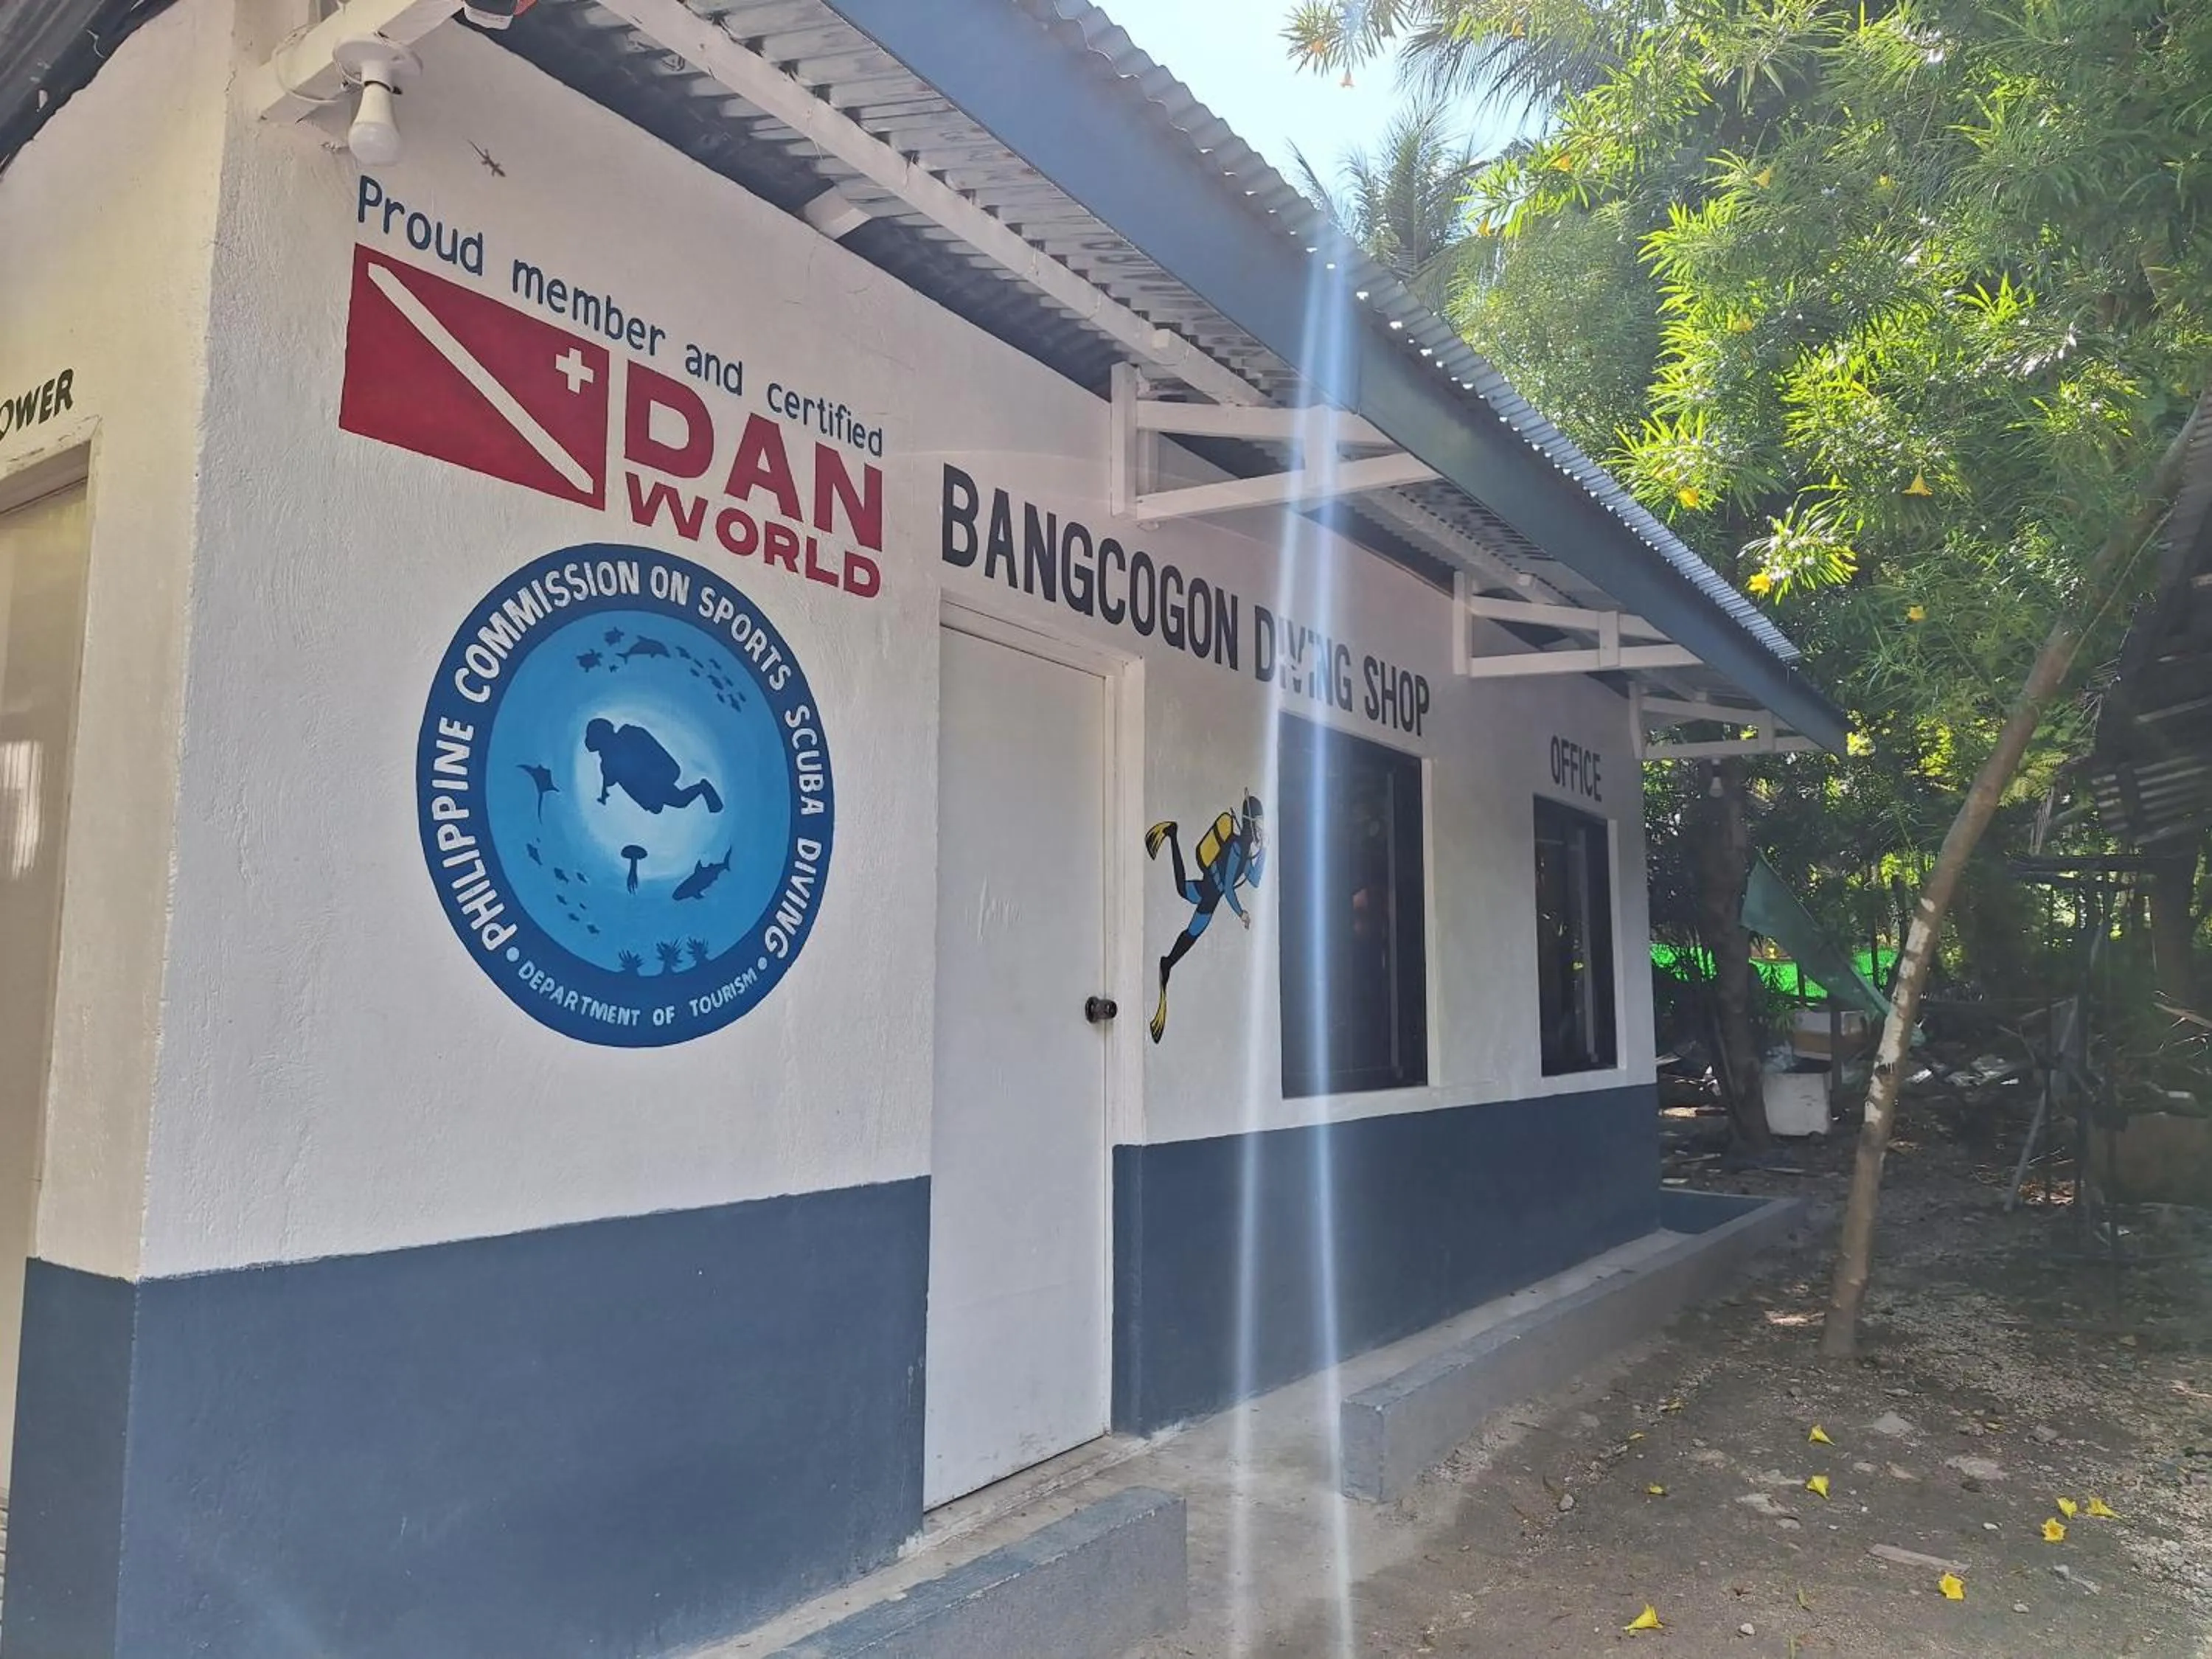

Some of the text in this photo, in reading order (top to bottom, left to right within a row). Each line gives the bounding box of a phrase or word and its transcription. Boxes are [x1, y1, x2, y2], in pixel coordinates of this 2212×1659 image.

[358, 175, 883, 457] Proud member and certified
[625, 360, 883, 552] DAN
[625, 471, 880, 598] WORLD
[942, 462, 1430, 737] BANGCOGON DIVING SHOP
[431, 560, 824, 959] PHILIPPINE COMMISSION ON SPORTS SCUBA DIVING
[1551, 735, 1602, 803] OFFICE
[519, 961, 757, 1026] DEPARTMENT OF TOURISM
